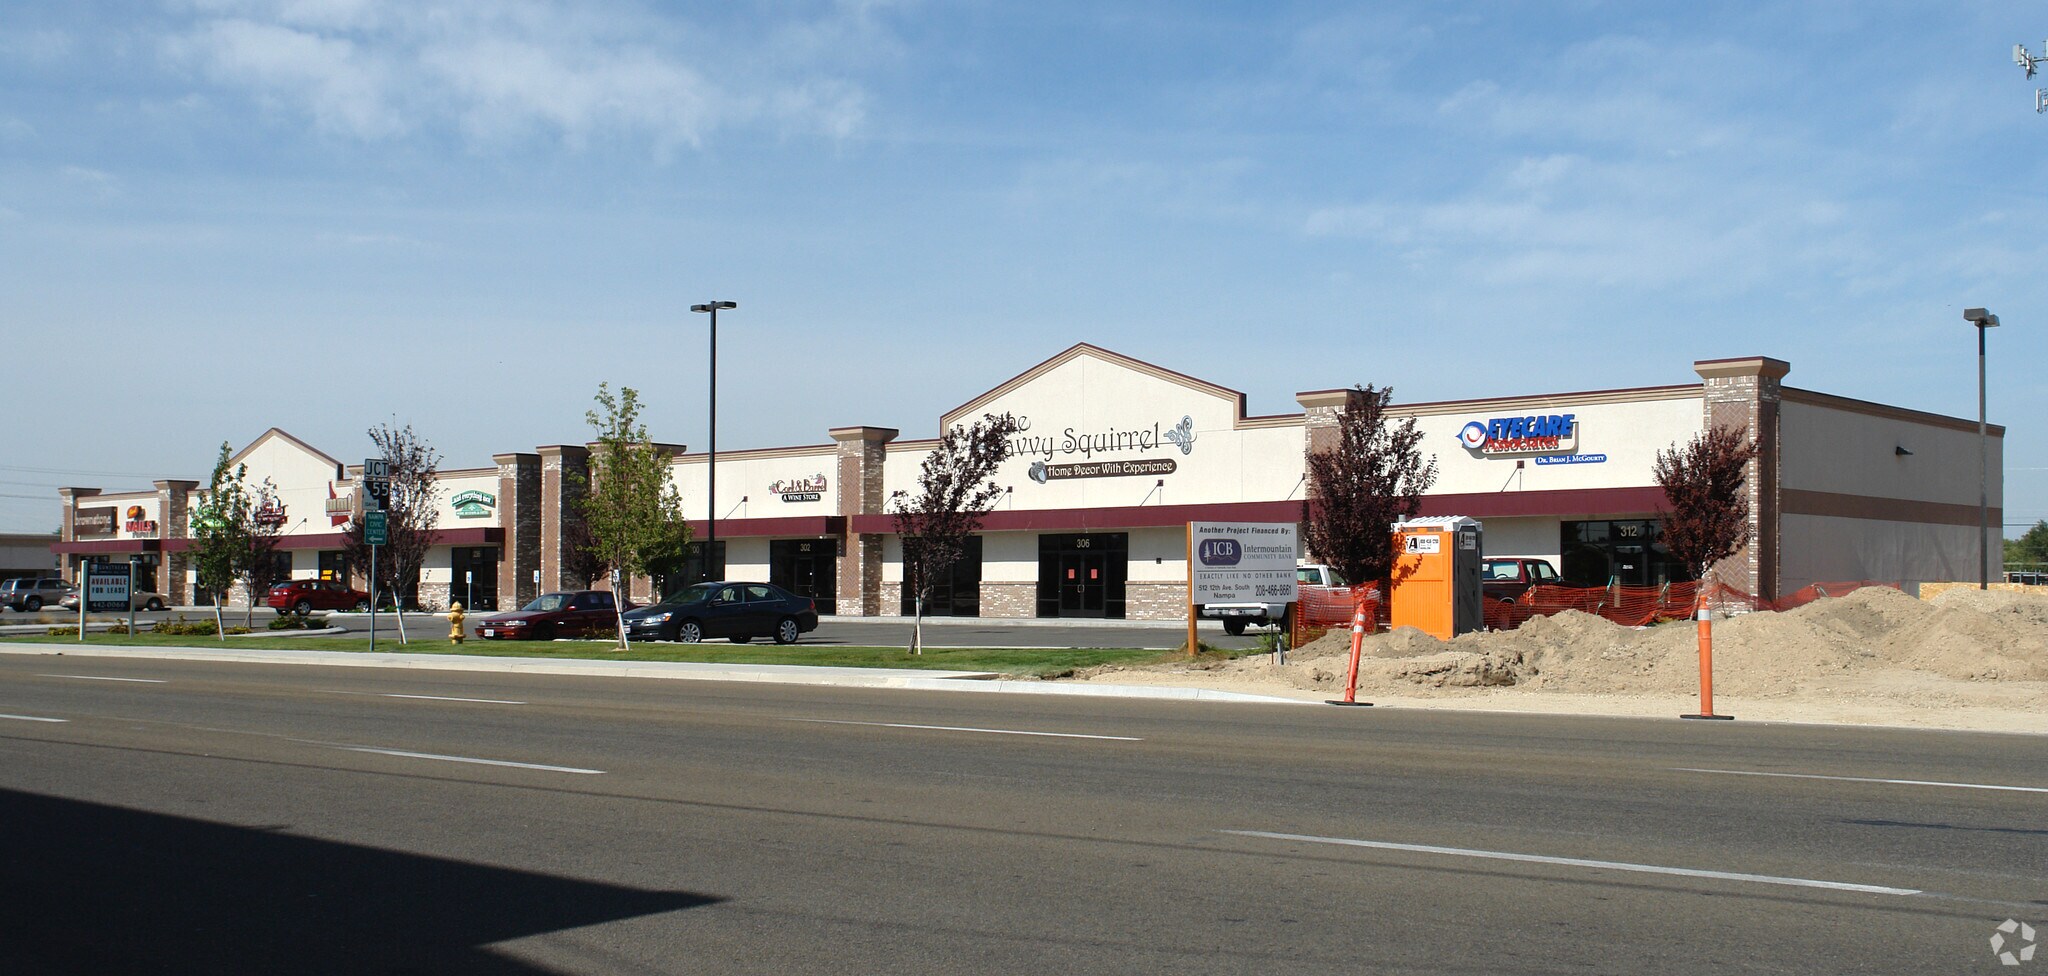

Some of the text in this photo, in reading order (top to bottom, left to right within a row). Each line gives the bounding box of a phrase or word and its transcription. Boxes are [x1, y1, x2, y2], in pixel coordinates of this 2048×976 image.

[1487, 414, 1576, 439] EYECARE
[1061, 421, 1160, 459] Squirrel
[366, 461, 389, 476] JCT
[1047, 461, 1174, 477] Home Decor With Experience
[373, 482, 389, 496] 55
[126, 521, 152, 533] NAILS
[1199, 526, 1224, 534] Another
[1226, 526, 1249, 535] Project
[1620, 525, 1637, 537] 312
[800, 543, 811, 552] 302
[1076, 539, 1090, 549] 306
[1213, 541, 1233, 556] ICB
[1244, 544, 1292, 553] Intermountain
[91, 578, 127, 586] AVAILABLE
